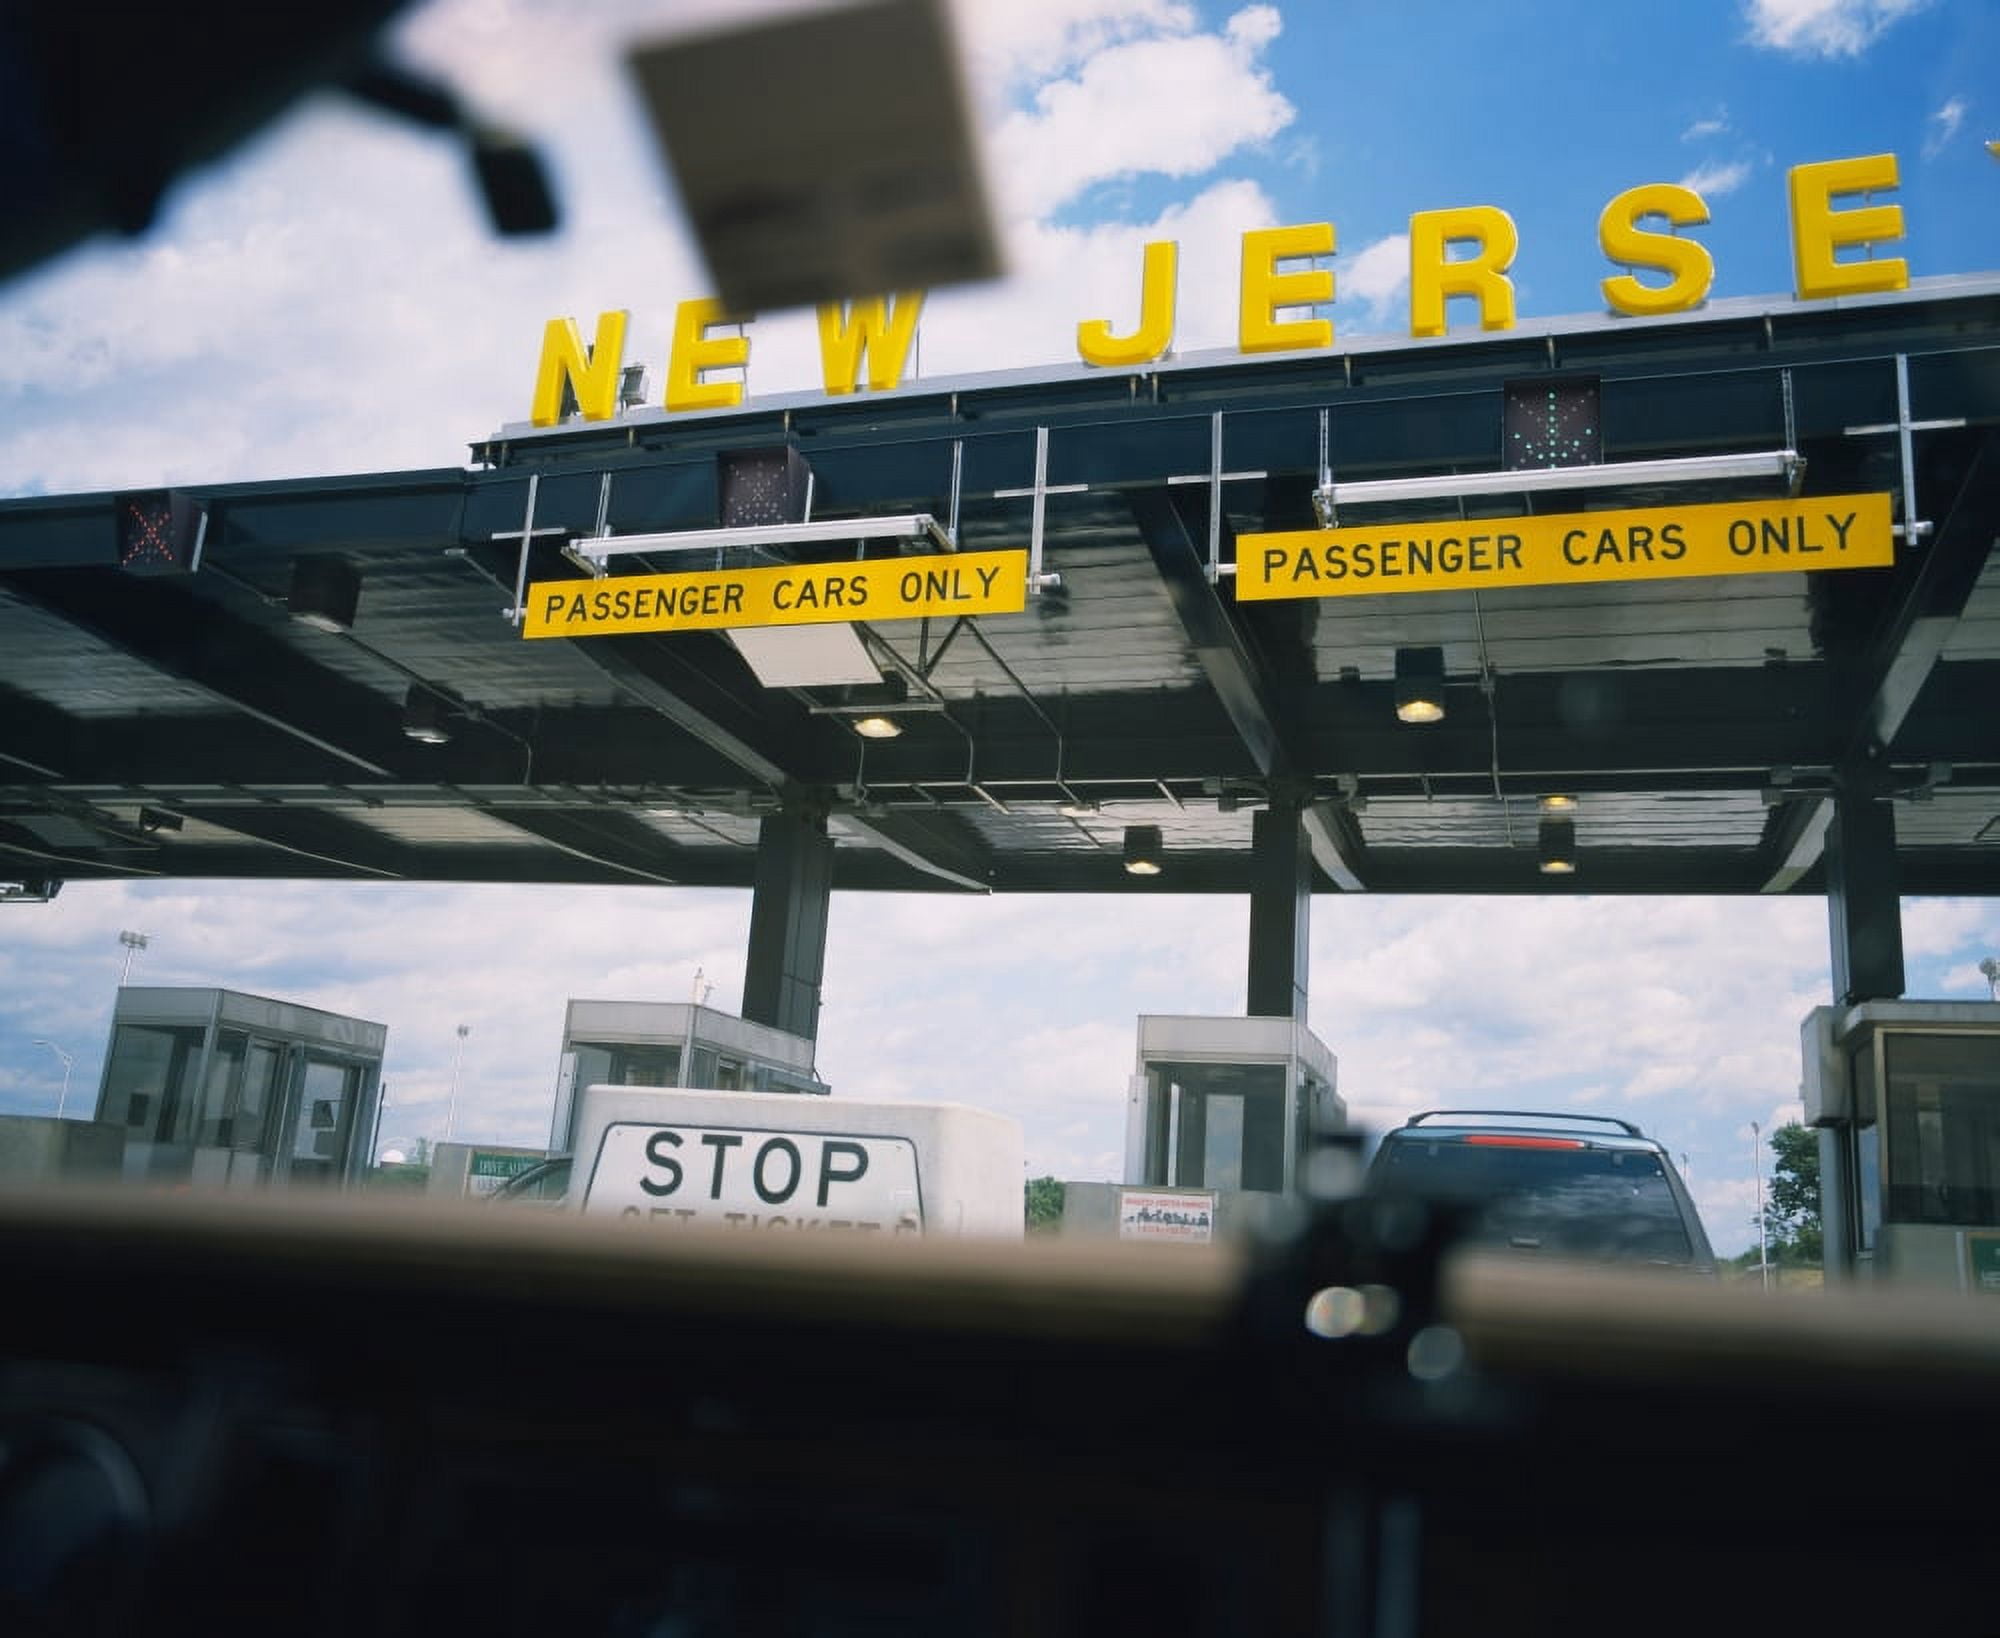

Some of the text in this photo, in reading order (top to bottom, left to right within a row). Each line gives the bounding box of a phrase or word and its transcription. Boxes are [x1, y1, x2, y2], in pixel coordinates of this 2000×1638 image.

[530, 141, 2000, 428] NEW JERSE
[1264, 511, 1857, 583] PASSENGER CARS ONLY
[545, 567, 999, 624] PASSENGER CARS ONLY
[639, 1131, 869, 1207] STOP
